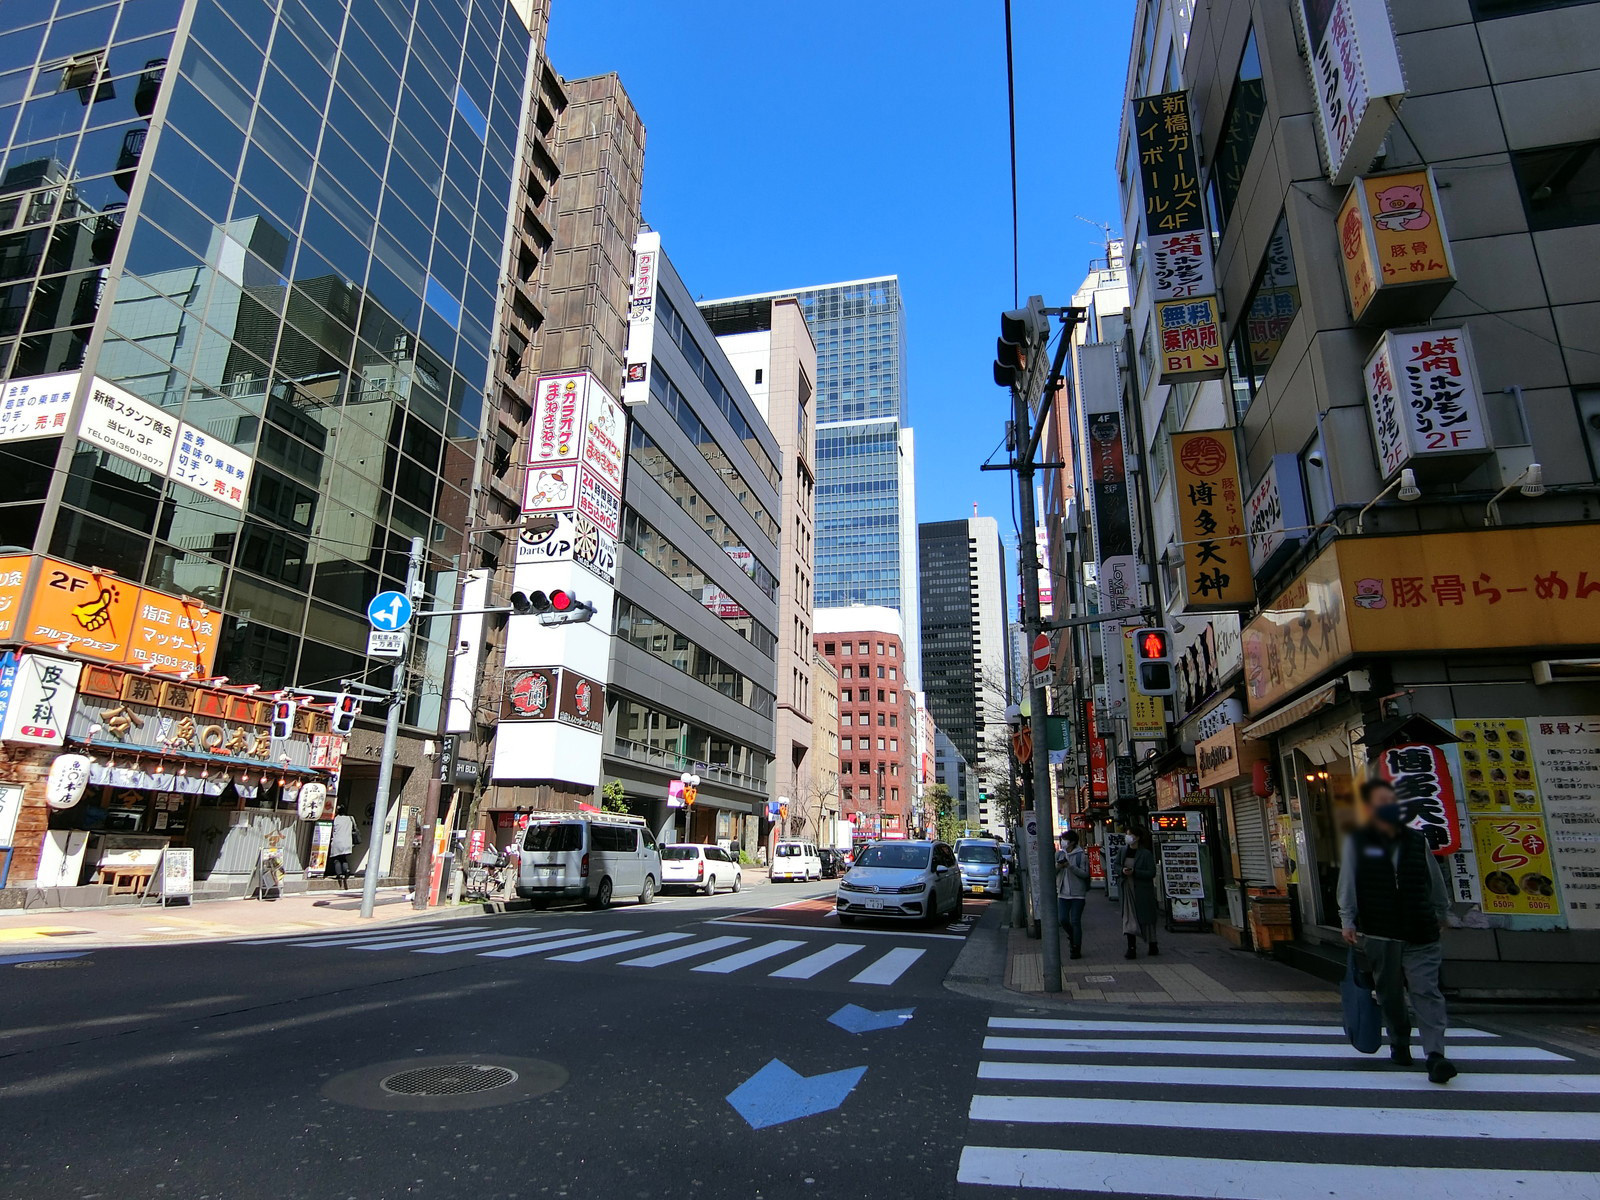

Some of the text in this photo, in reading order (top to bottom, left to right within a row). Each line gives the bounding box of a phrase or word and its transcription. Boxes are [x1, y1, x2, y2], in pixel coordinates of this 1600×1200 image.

[1137, 101, 1169, 214] ハイボール
[1162, 94, 1197, 209] 新橋ガールズ
[1158, 212, 1189, 230] 4F
[1161, 232, 1205, 257] 焼肉
[1390, 241, 1429, 258] 豚骨
[639, 255, 650, 296] カラオケ
[1382, 257, 1444, 275] らーめん
[1171, 284, 1200, 298] 2F
[1160, 301, 1213, 328] 無料
[1163, 325, 1220, 352] 案内所
[1168, 355, 1193, 371] B1
[1409, 336, 1462, 377] 焼肉
[4, 391, 72, 411] 趣味の乗車券
[9, 385, 29, 398] 金券
[1430, 375, 1468, 428] ホルモン
[2, 410, 22, 423] 切手
[93, 389, 174, 439] 新橋スタンプ商会
[539, 381, 562, 460] まねきねこ
[559, 389, 579, 447] カラオケ
[1097, 414, 1111, 423] 4F
[106, 418, 155, 448] 当ビル3F
[183, 430, 206, 447] 金券
[592, 424, 618, 456] カラオケ
[1425, 430, 1471, 449] 2F
[86, 426, 165, 468] TEL 03(3501)3077
[585, 435, 620, 486] まねきねこ
[1386, 443, 1403, 474] 2F
[178, 453, 201, 471] 切手
[180, 442, 246, 481] 趣味の乗車券
[1100, 440, 1115, 482] JACKS
[175, 467, 210, 488] コイン
[580, 495, 618, 535] 持ち込みOK
[1221, 477, 1243, 547] 豚骨らーめん
[519, 539, 572, 558] Darts UP
[1187, 480, 1231, 601] 博多天神
[49, 570, 89, 593] 2F
[1391, 570, 1600, 609] 豚骨らーめん
[141, 604, 213, 637] 指圧 はり灸
[1107, 624, 1117, 633] 2F
[142, 626, 207, 655] マッサージ
[133, 648, 149, 661] TEL
[32, 666, 64, 726] 皮フ科
[1523, 834, 1543, 855] 辛
[1493, 900, 1515, 908] 650円
[1528, 901, 1551, 910] 600円
